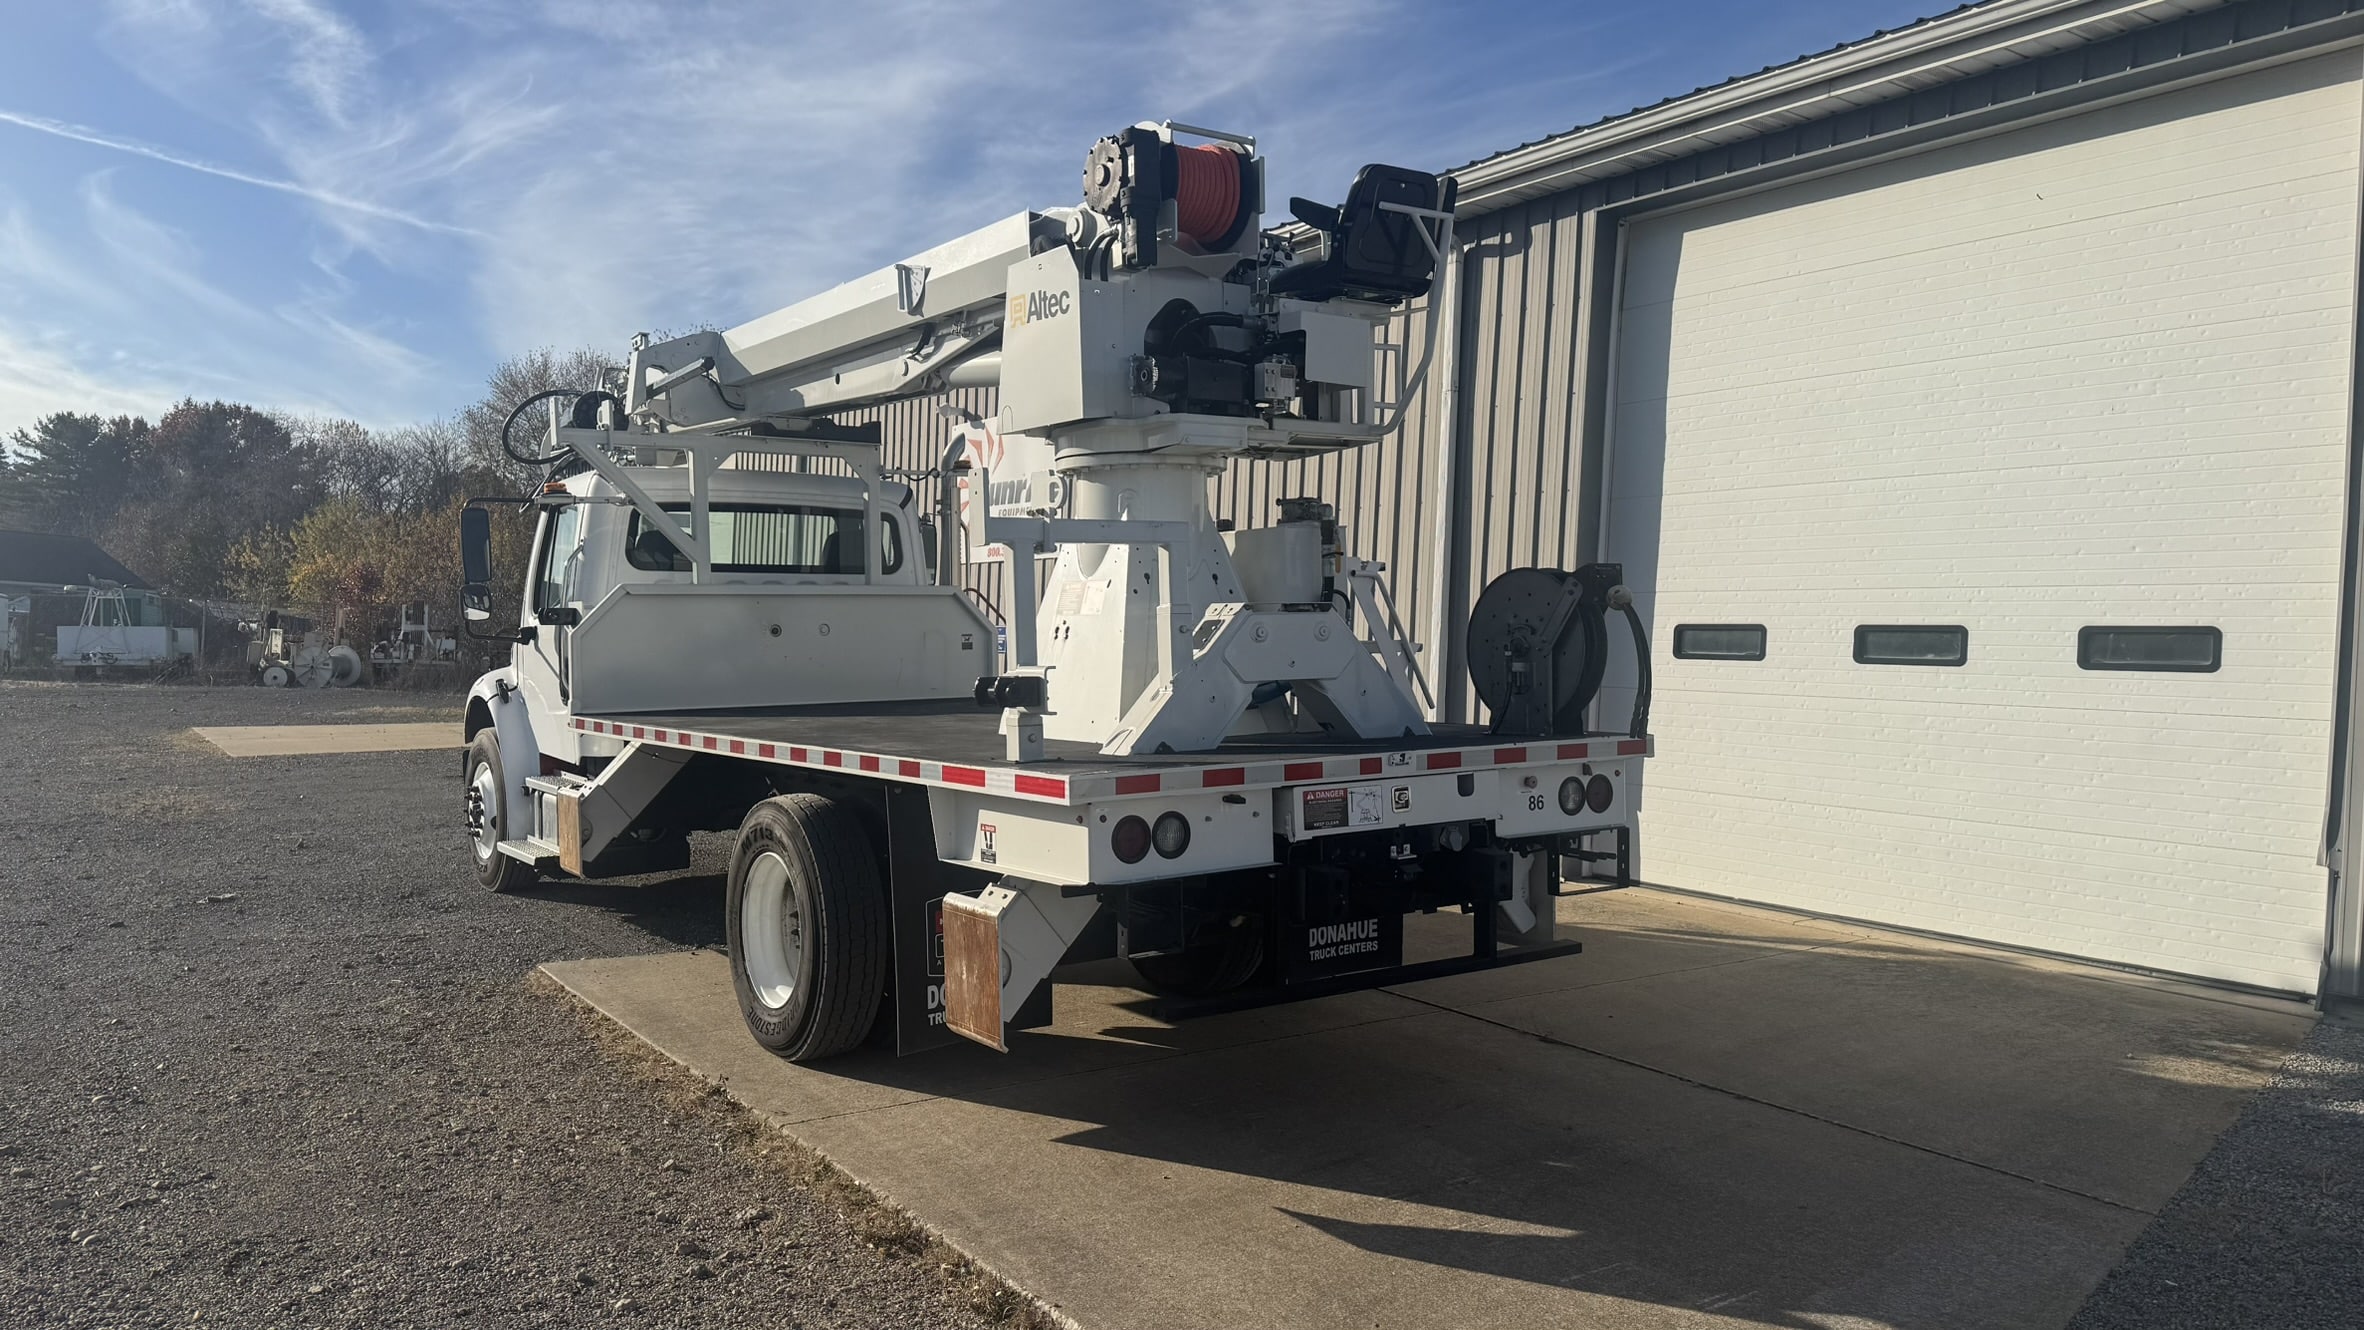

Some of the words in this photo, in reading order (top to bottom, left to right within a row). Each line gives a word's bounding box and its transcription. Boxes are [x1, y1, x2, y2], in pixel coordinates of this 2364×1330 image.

[1026, 290, 1070, 323] Altec
[1315, 789, 1344, 799] DANGER
[1528, 794, 1544, 811] 86
[1309, 918, 1378, 948] DONAHUE
[1309, 946, 1336, 961] TRUCK
[1338, 940, 1378, 956] CENTERS
